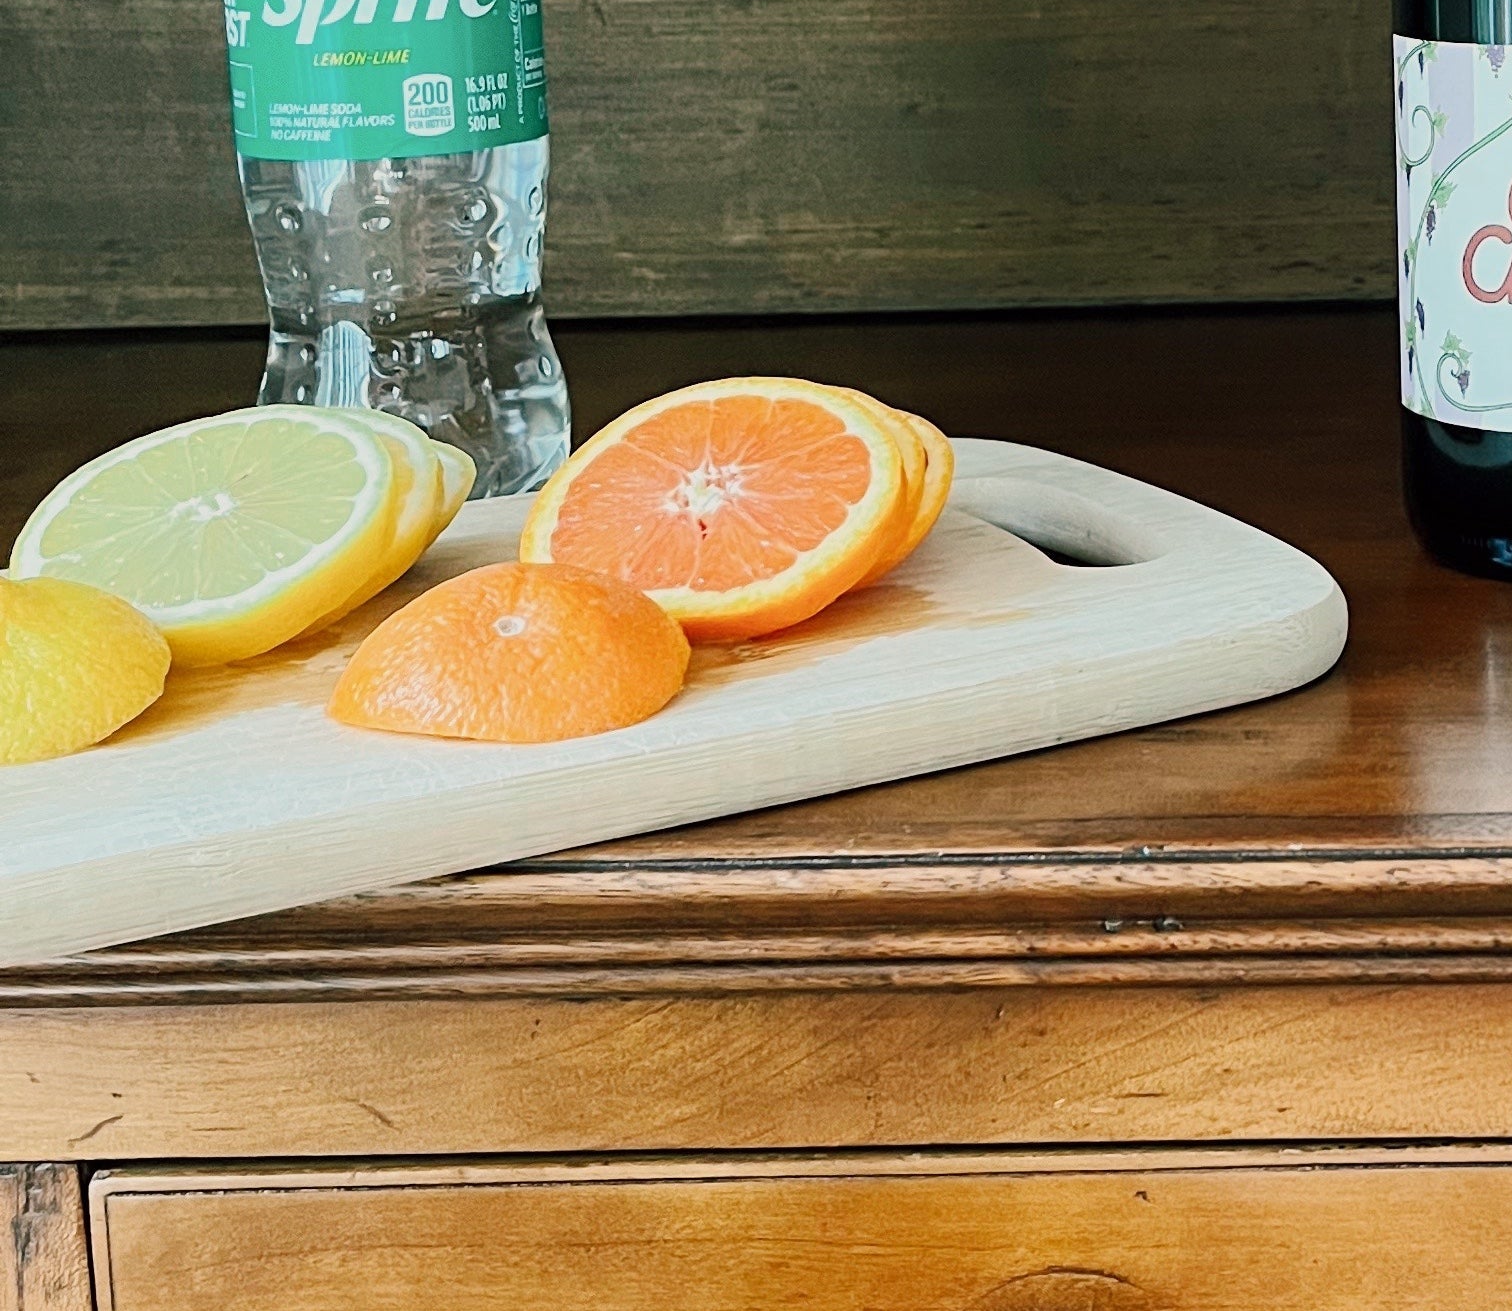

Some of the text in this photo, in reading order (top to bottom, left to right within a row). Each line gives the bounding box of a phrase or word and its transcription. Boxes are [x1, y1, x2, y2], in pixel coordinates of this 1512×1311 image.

[313, 49, 411, 66] LEMON-LIME
[465, 76, 486, 93] 16.9
[408, 81, 449, 106] 200
[330, 103, 363, 115] SODA
[408, 105, 451, 118] CALORIES
[342, 114, 396, 128] FLAVORS
[467, 114, 487, 133] 500
